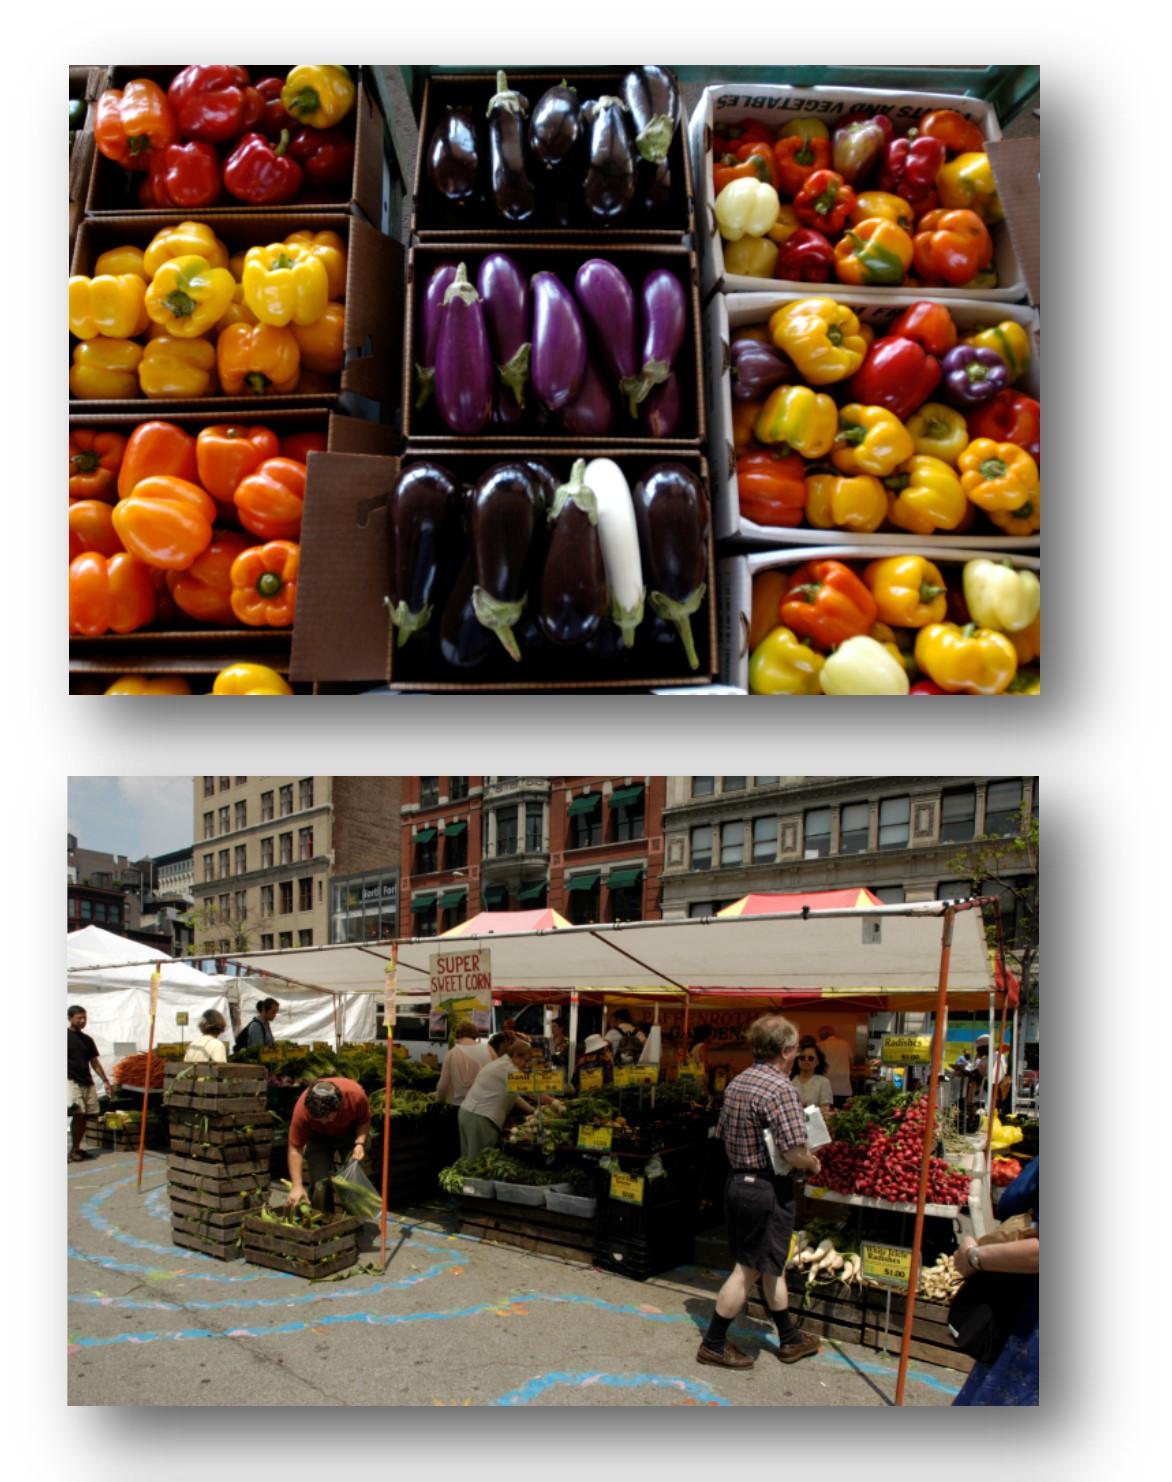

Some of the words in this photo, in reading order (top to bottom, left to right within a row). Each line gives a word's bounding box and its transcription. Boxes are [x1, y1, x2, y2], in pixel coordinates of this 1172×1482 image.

[716, 94, 844, 114] VEGETABLES
[437, 954, 480, 974] SUPER
[431, 974, 463, 993] SWEET
[465, 973, 492, 991] CORN
[885, 1037, 922, 1047] Radishes
[884, 1268, 906, 1278] $1.00
